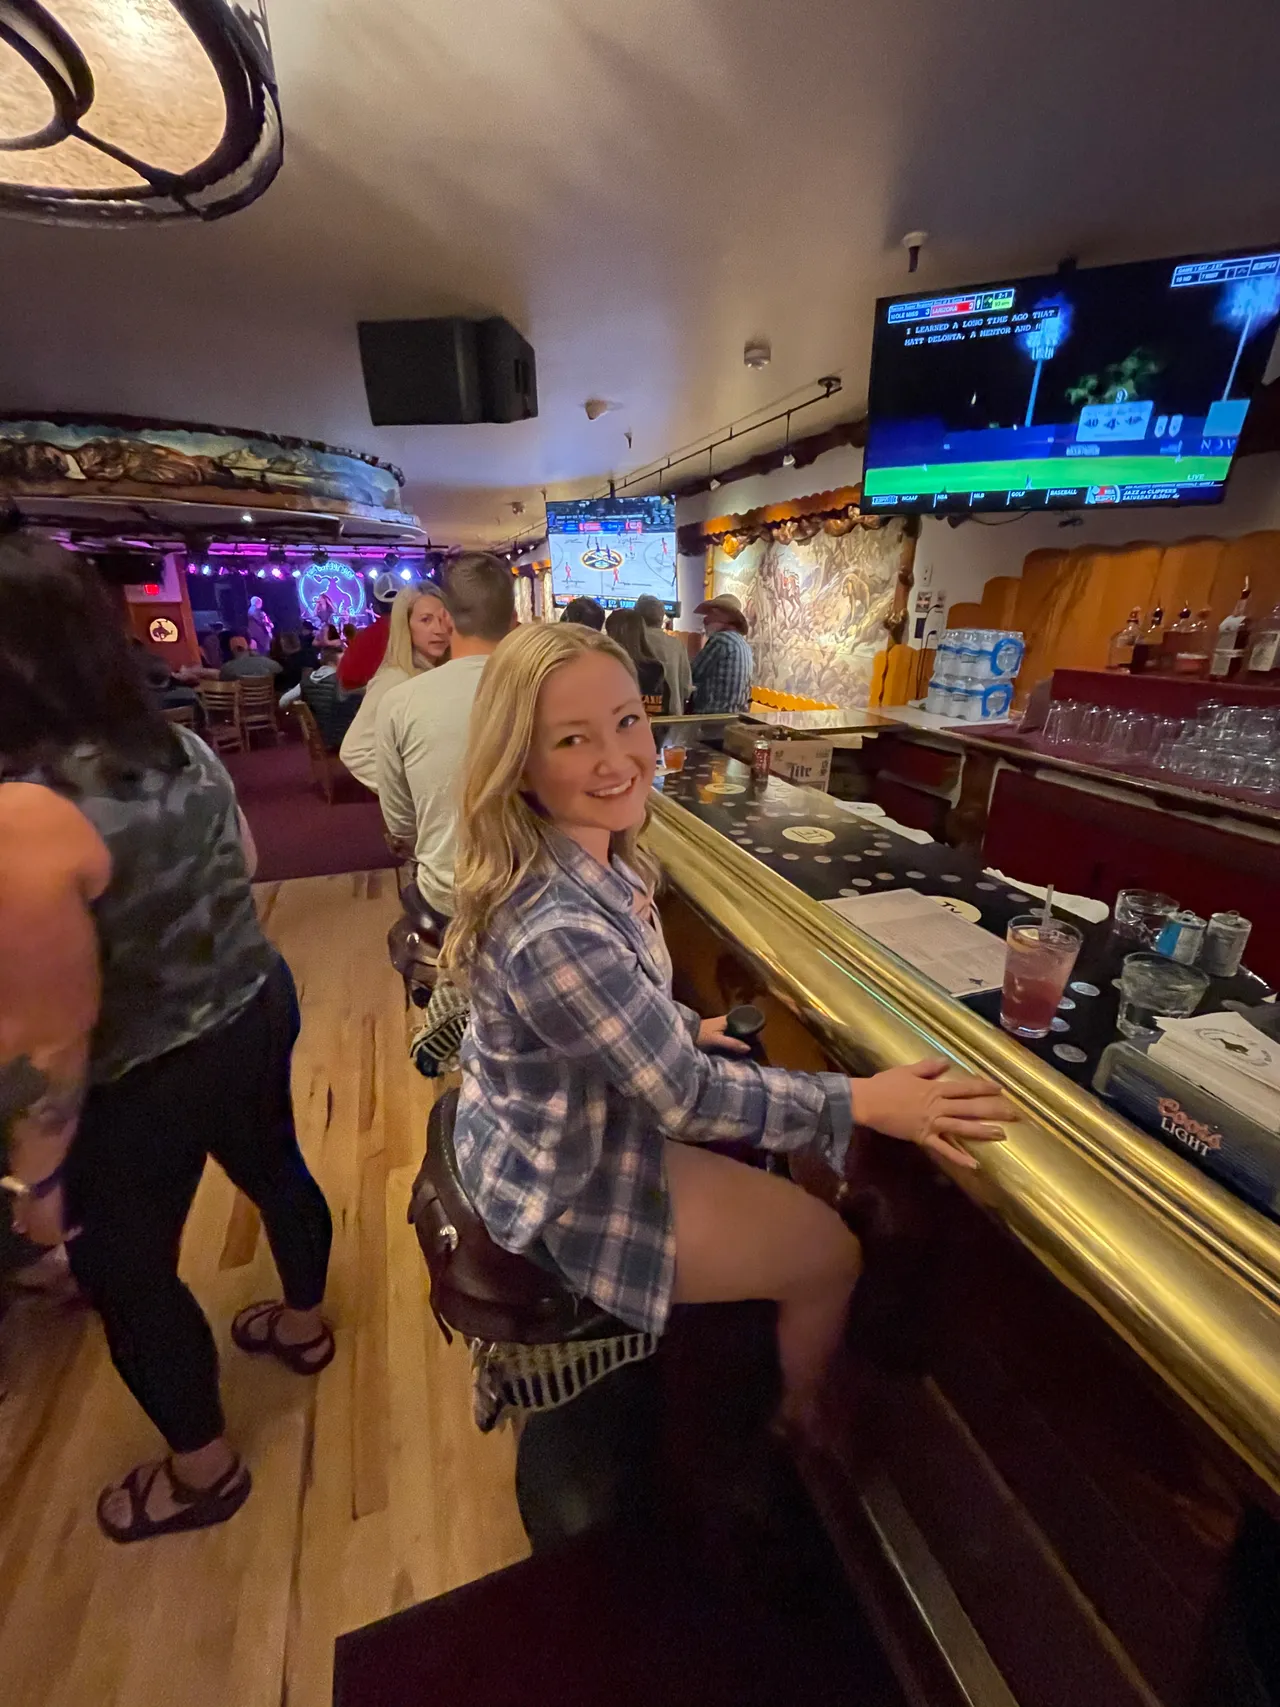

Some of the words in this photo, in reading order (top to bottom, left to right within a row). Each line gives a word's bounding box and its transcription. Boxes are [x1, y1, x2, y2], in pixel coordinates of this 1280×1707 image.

[906, 327, 911, 335] I
[915, 323, 950, 334] LEARNED
[952, 321, 959, 330] A
[962, 318, 984, 328] LONG
[987, 315, 1009, 325] TIME
[1011, 312, 1029, 322] AGO
[1032, 309, 1055, 319] THAT
[925, 308, 930, 316] 3
[904, 337, 925, 346] MATT
[970, 330, 977, 339] A
[979, 326, 1012, 337] MENTOR
[1014, 324, 1032, 333] AND
[1050, 488, 1078, 496] BASEBALL
[1161, 1116, 1209, 1156] LIGHT
